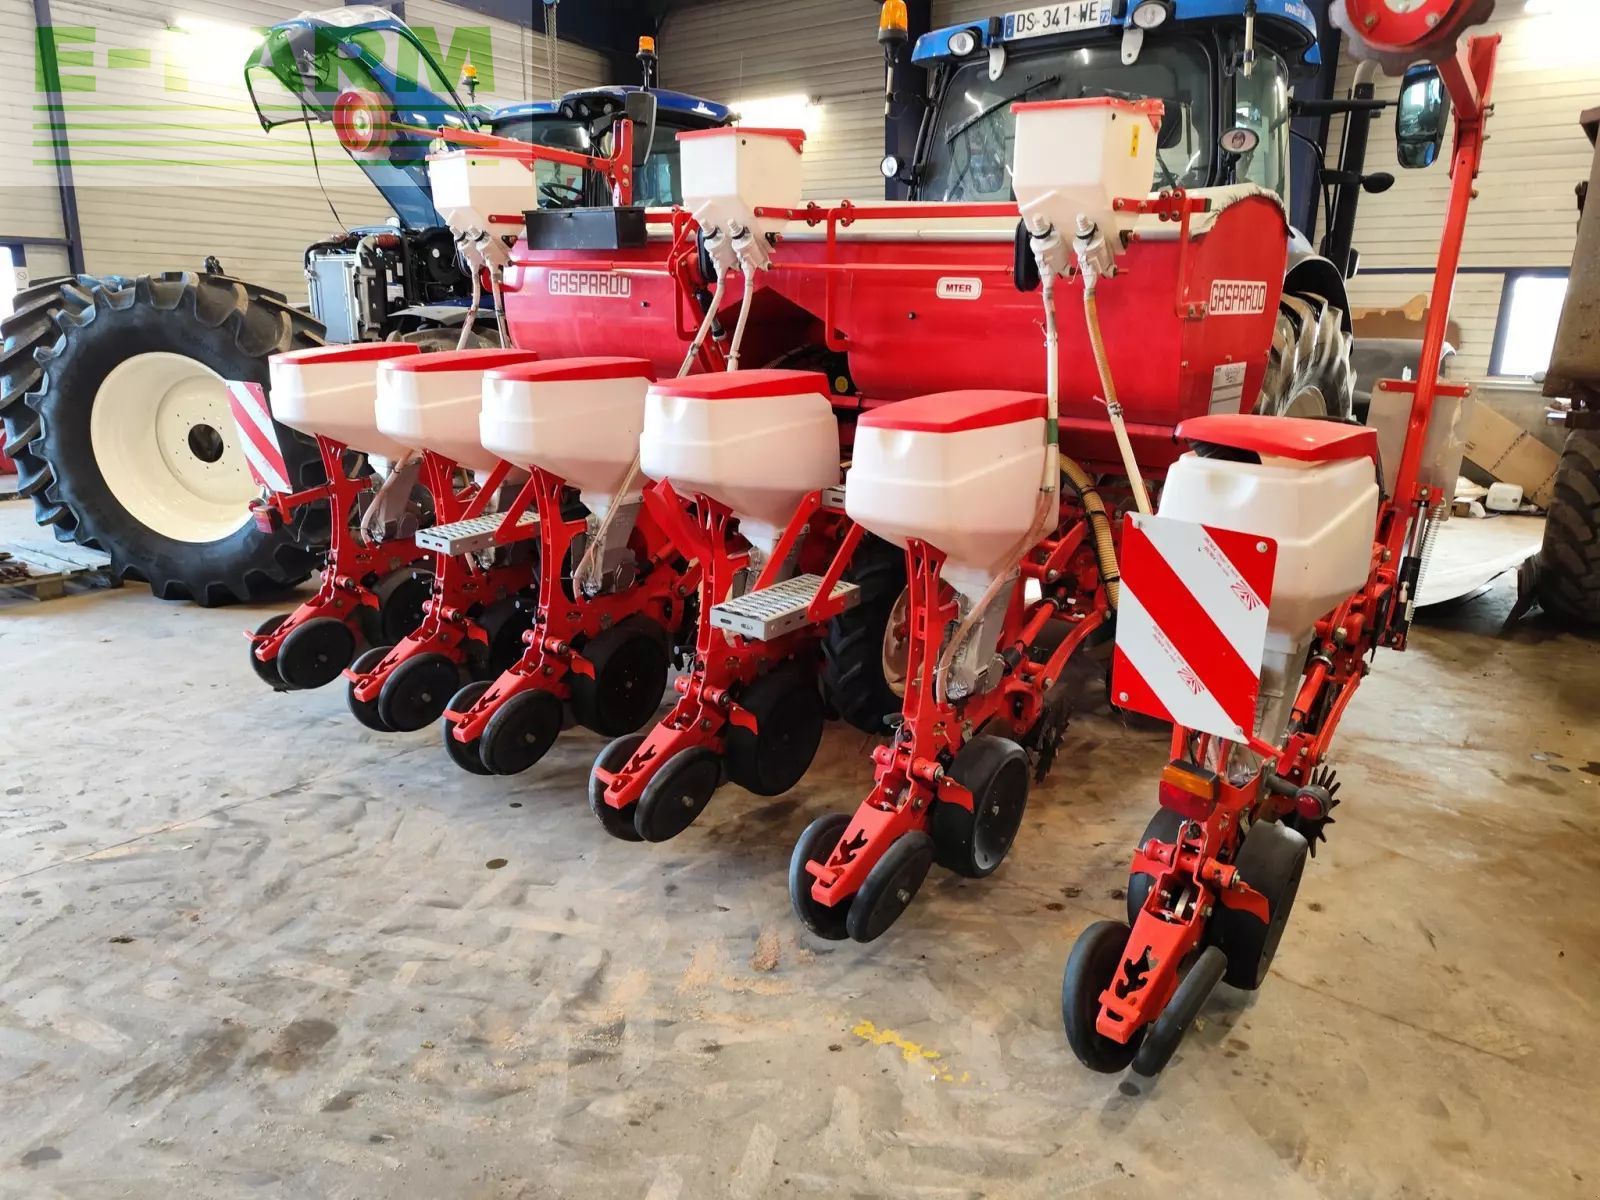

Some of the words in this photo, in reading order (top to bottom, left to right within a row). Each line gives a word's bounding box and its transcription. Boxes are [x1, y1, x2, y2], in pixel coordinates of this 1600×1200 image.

[549, 272, 631, 296] GASPARDO
[945, 283, 972, 293] MTER
[1210, 283, 1267, 311] GASPARDO
